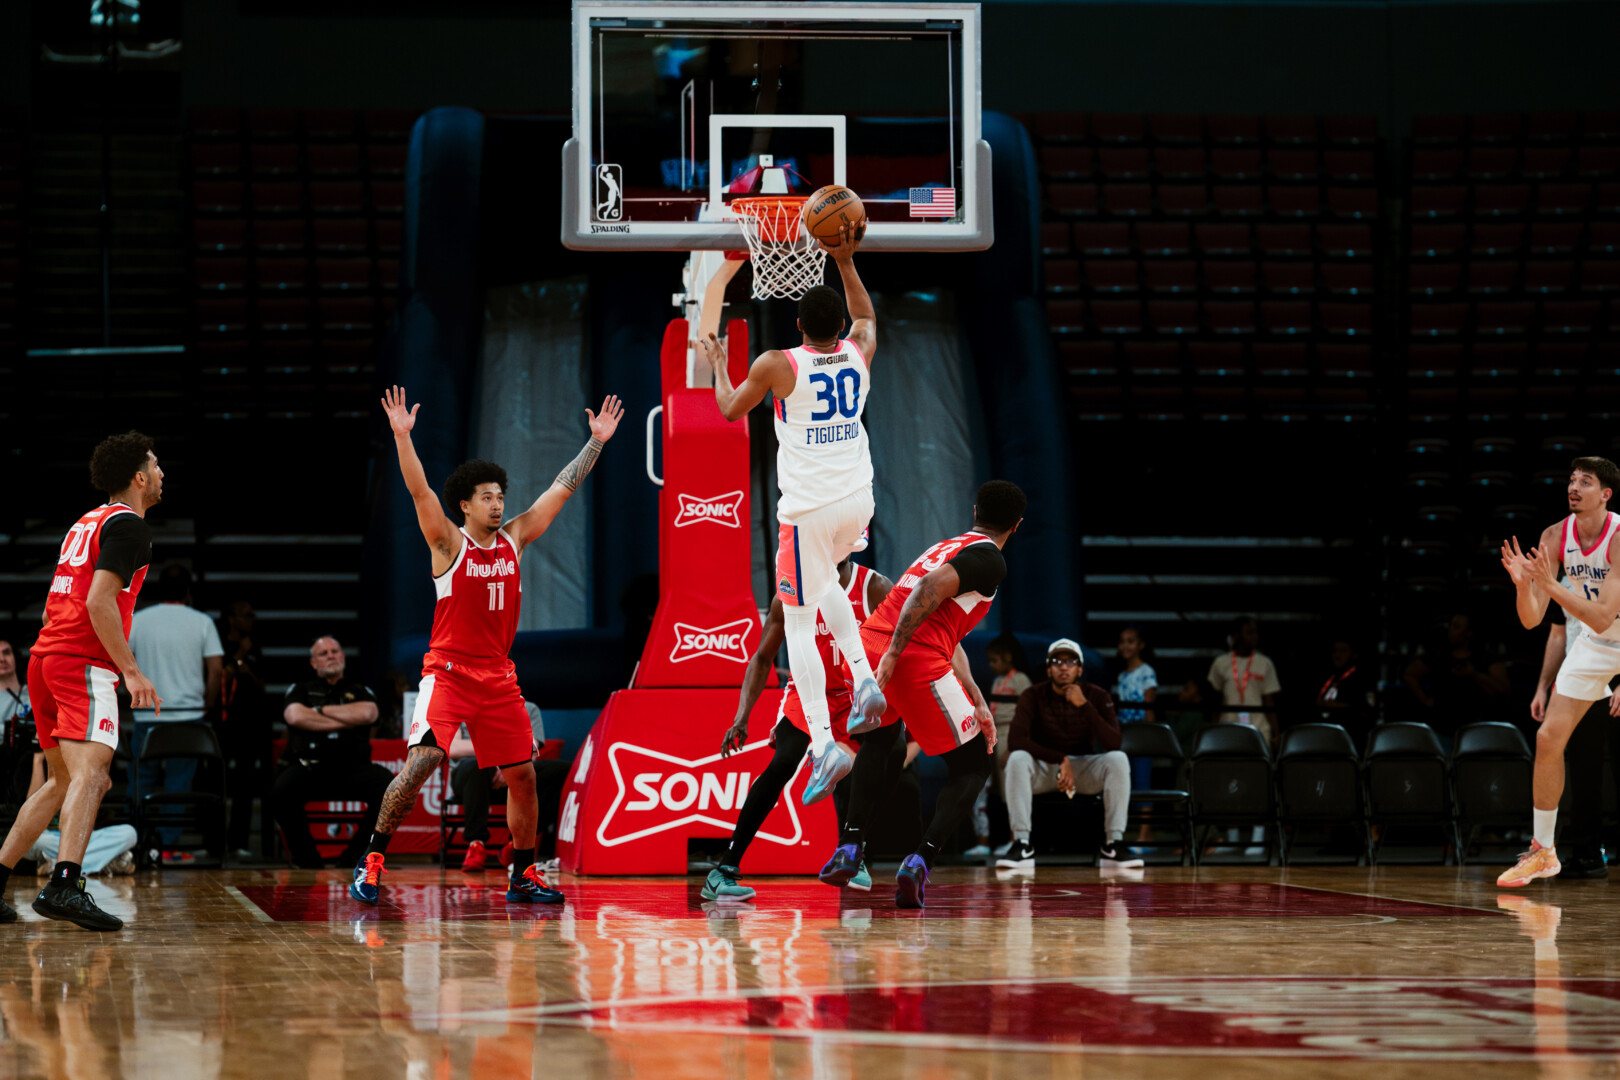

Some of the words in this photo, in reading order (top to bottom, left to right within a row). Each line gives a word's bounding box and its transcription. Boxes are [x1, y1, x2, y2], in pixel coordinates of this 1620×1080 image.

[813, 190, 851, 215] Wilson
[591, 224, 631, 234] SPALDING
[833, 353, 849, 364] LEAGUE
[809, 368, 860, 421] 30
[683, 503, 733, 517] SONIC
[57, 521, 98, 567] 00
[1566, 563, 1610, 580] APINE
[487, 581, 505, 611] 11
[680, 634, 741, 650] SONIC
[625, 772, 778, 811] SONI
